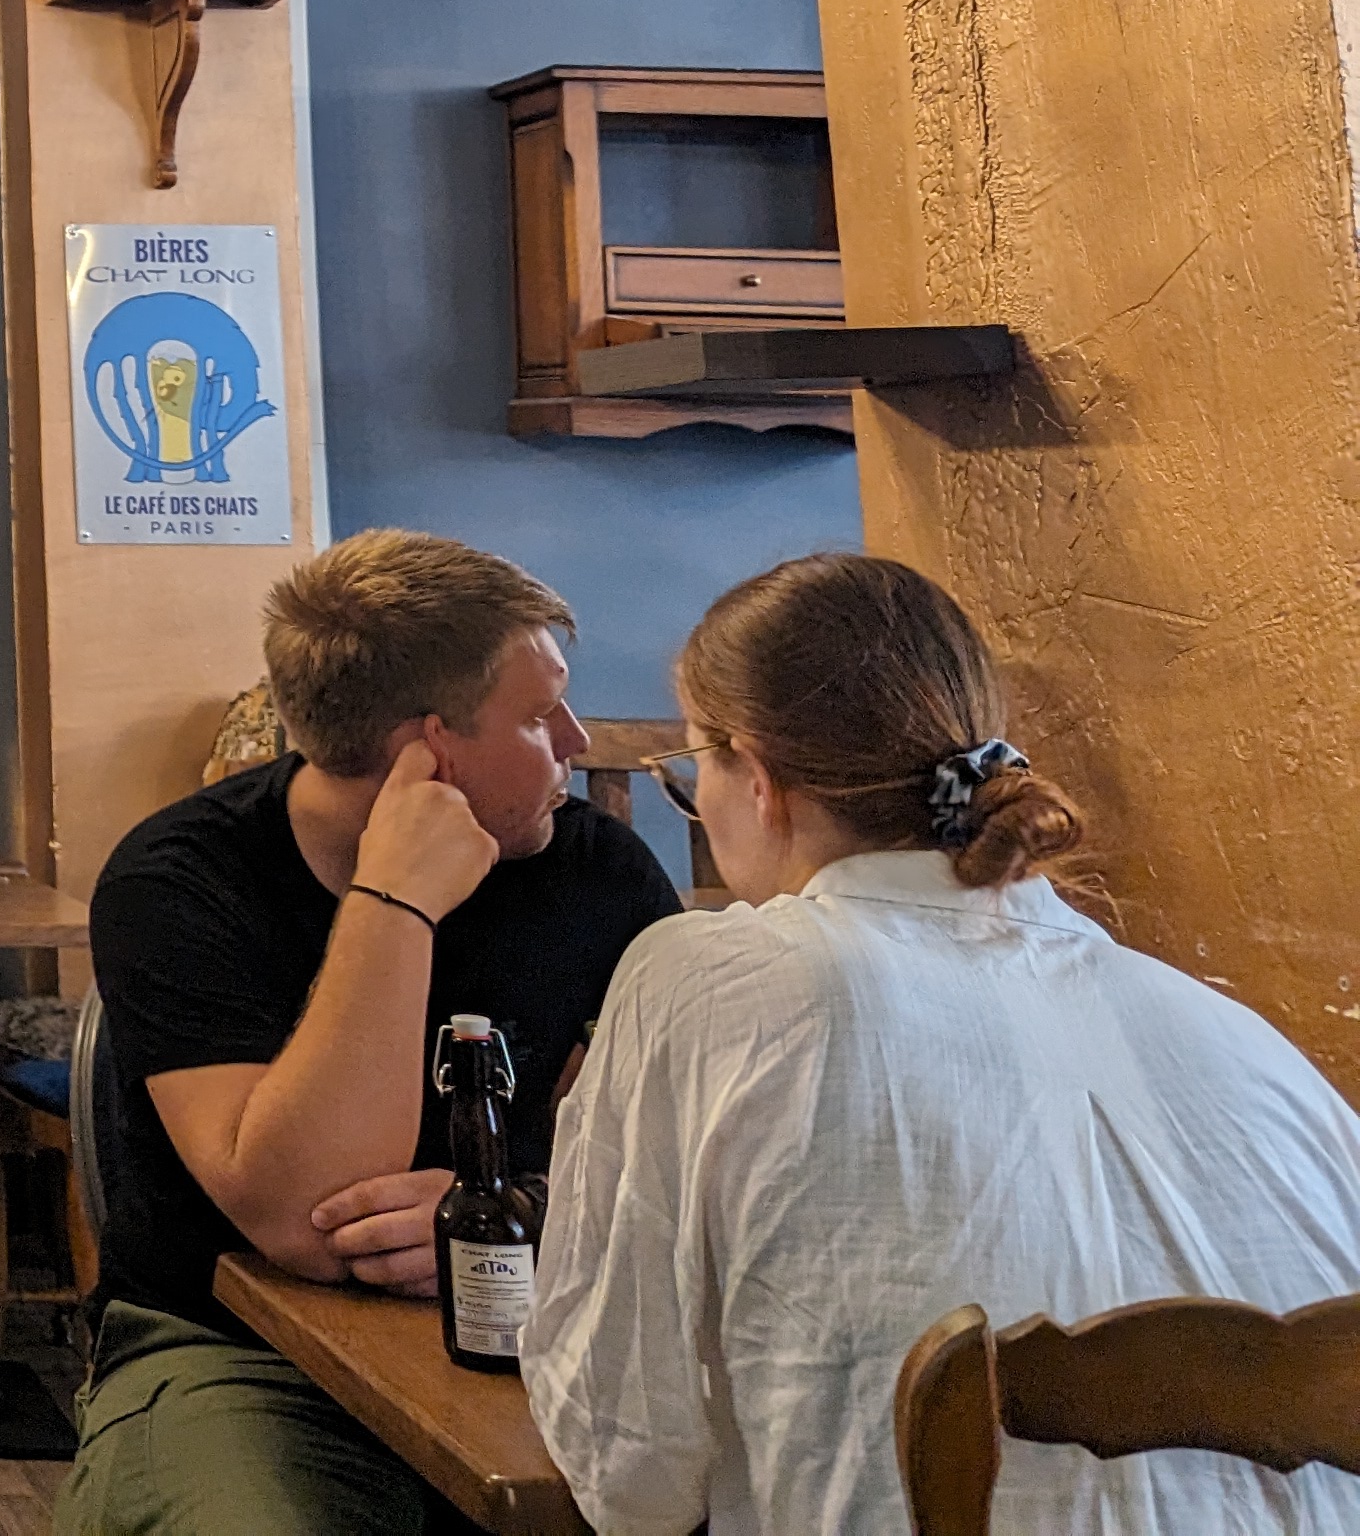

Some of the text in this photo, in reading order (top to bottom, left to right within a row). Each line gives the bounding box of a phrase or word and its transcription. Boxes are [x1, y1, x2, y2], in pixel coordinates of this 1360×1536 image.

[134, 232, 209, 263] BIÈRES
[86, 266, 255, 284] CHAT LONG
[105, 491, 258, 515] LE CAFÉ DES CHATS
[150, 521, 214, 535] PARIS
